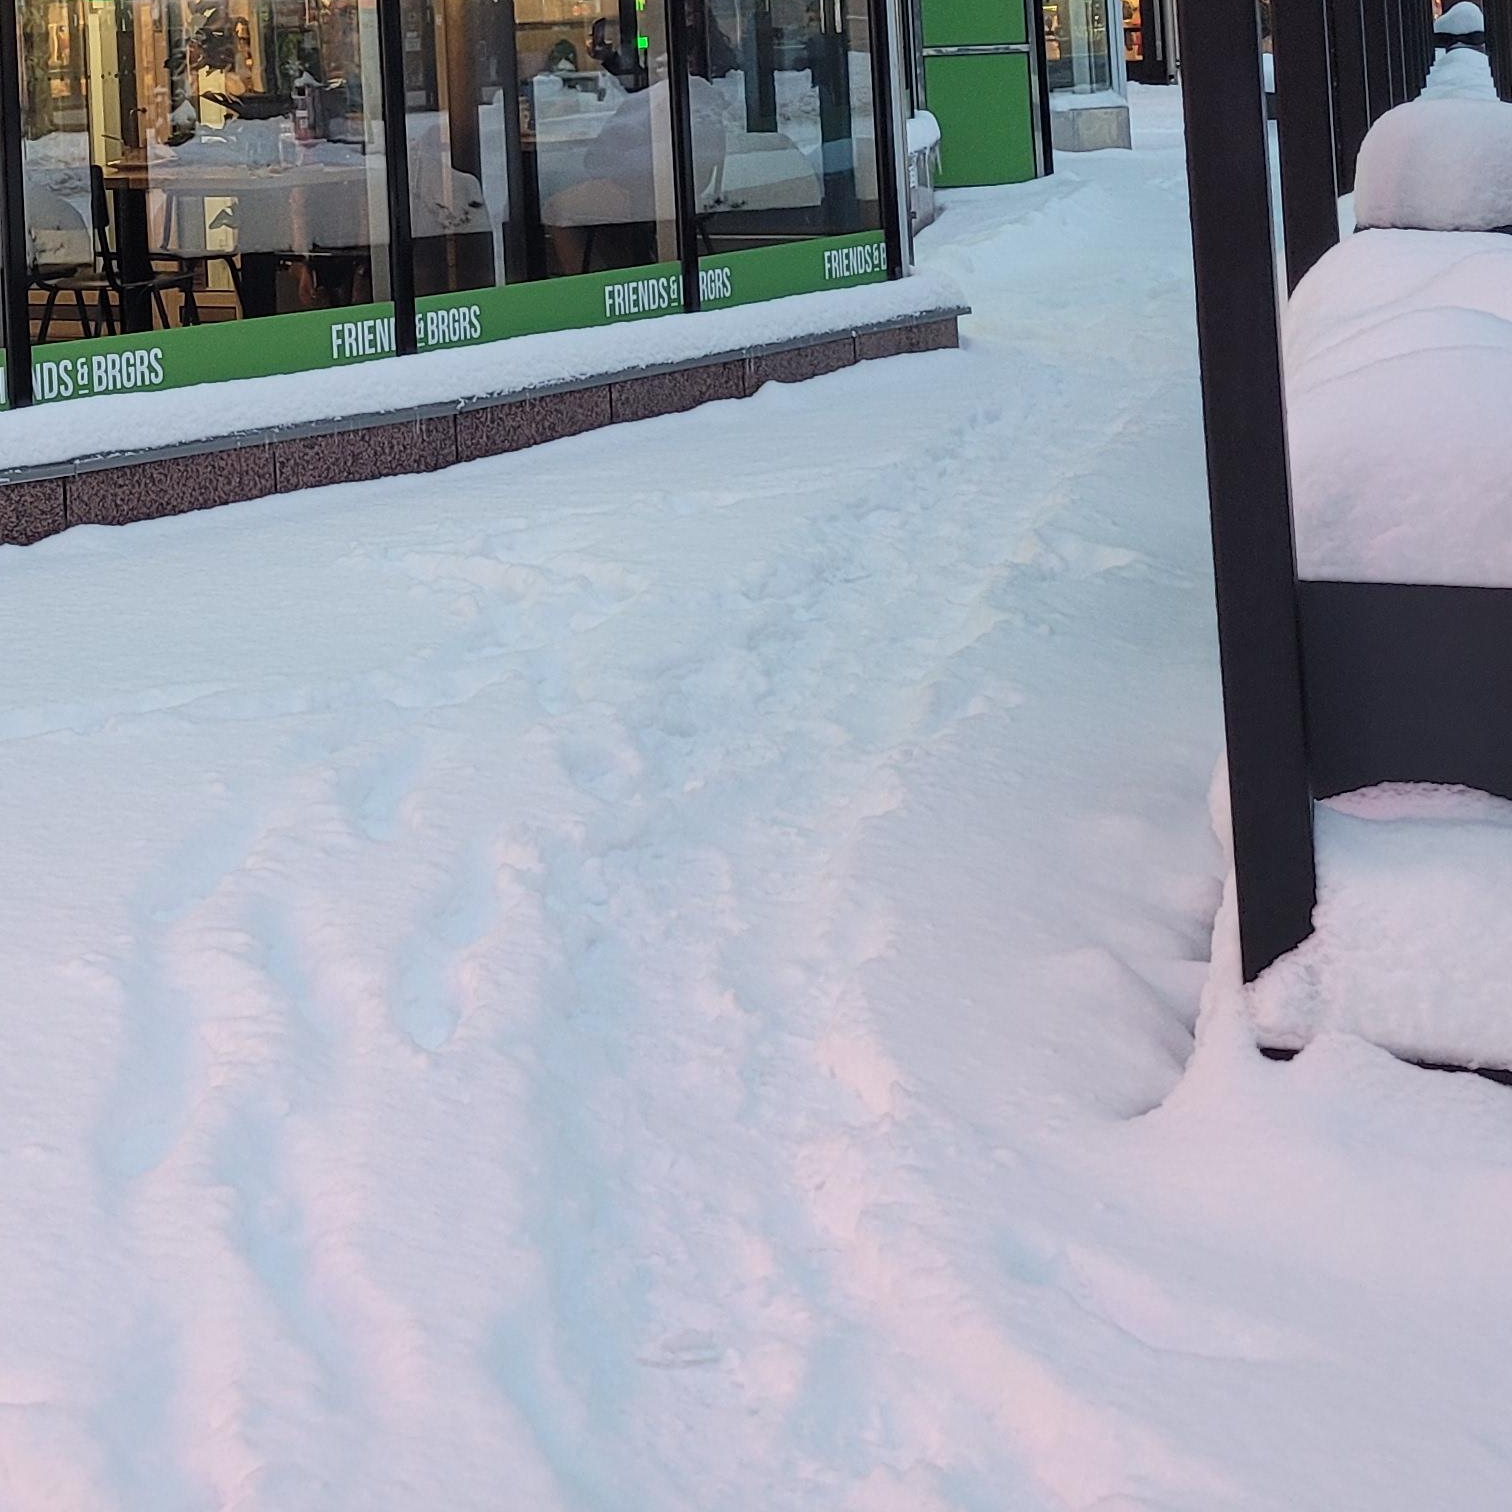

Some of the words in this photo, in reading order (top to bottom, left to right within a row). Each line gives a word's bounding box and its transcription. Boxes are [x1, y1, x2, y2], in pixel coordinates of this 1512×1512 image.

[824, 245, 872, 280] FRIENDS
[605, 277, 668, 317] FRIENDS
[670, 276, 678, 306] &
[427, 305, 481, 345] BRGRS
[77, 357, 89, 394] &
[92, 348, 163, 392] BRGRS
